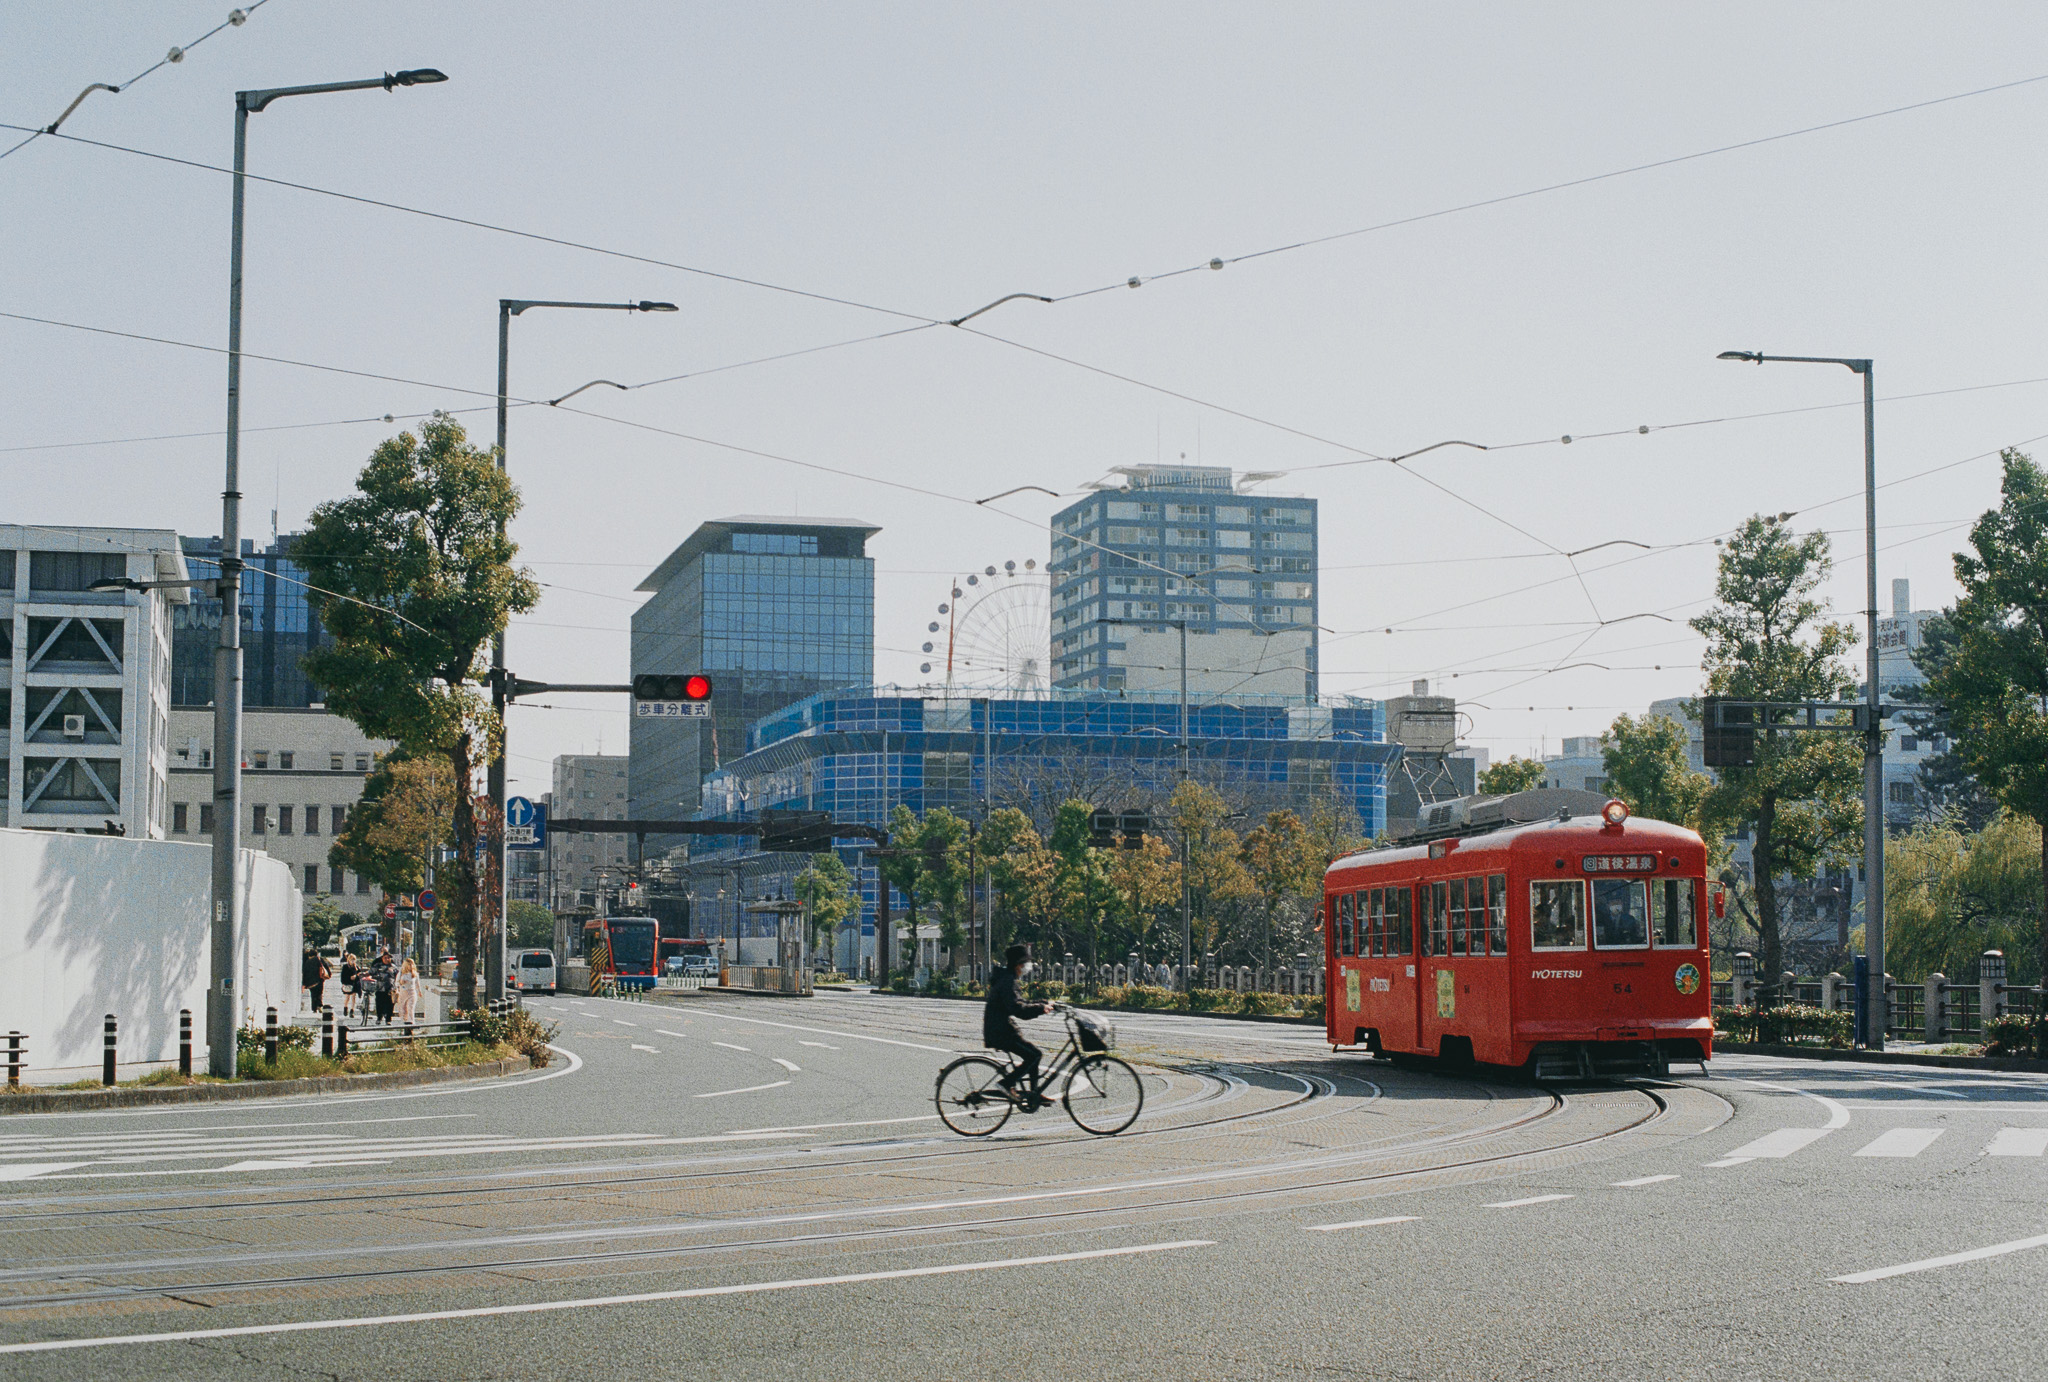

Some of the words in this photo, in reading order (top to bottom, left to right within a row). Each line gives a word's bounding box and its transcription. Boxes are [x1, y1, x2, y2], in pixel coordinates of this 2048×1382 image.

[639, 703, 706, 715] 歩車分離式
[1598, 857, 1652, 870] 道後温泉
[1532, 969, 1582, 979] IYOTETSU
[1614, 984, 1632, 994] 54
